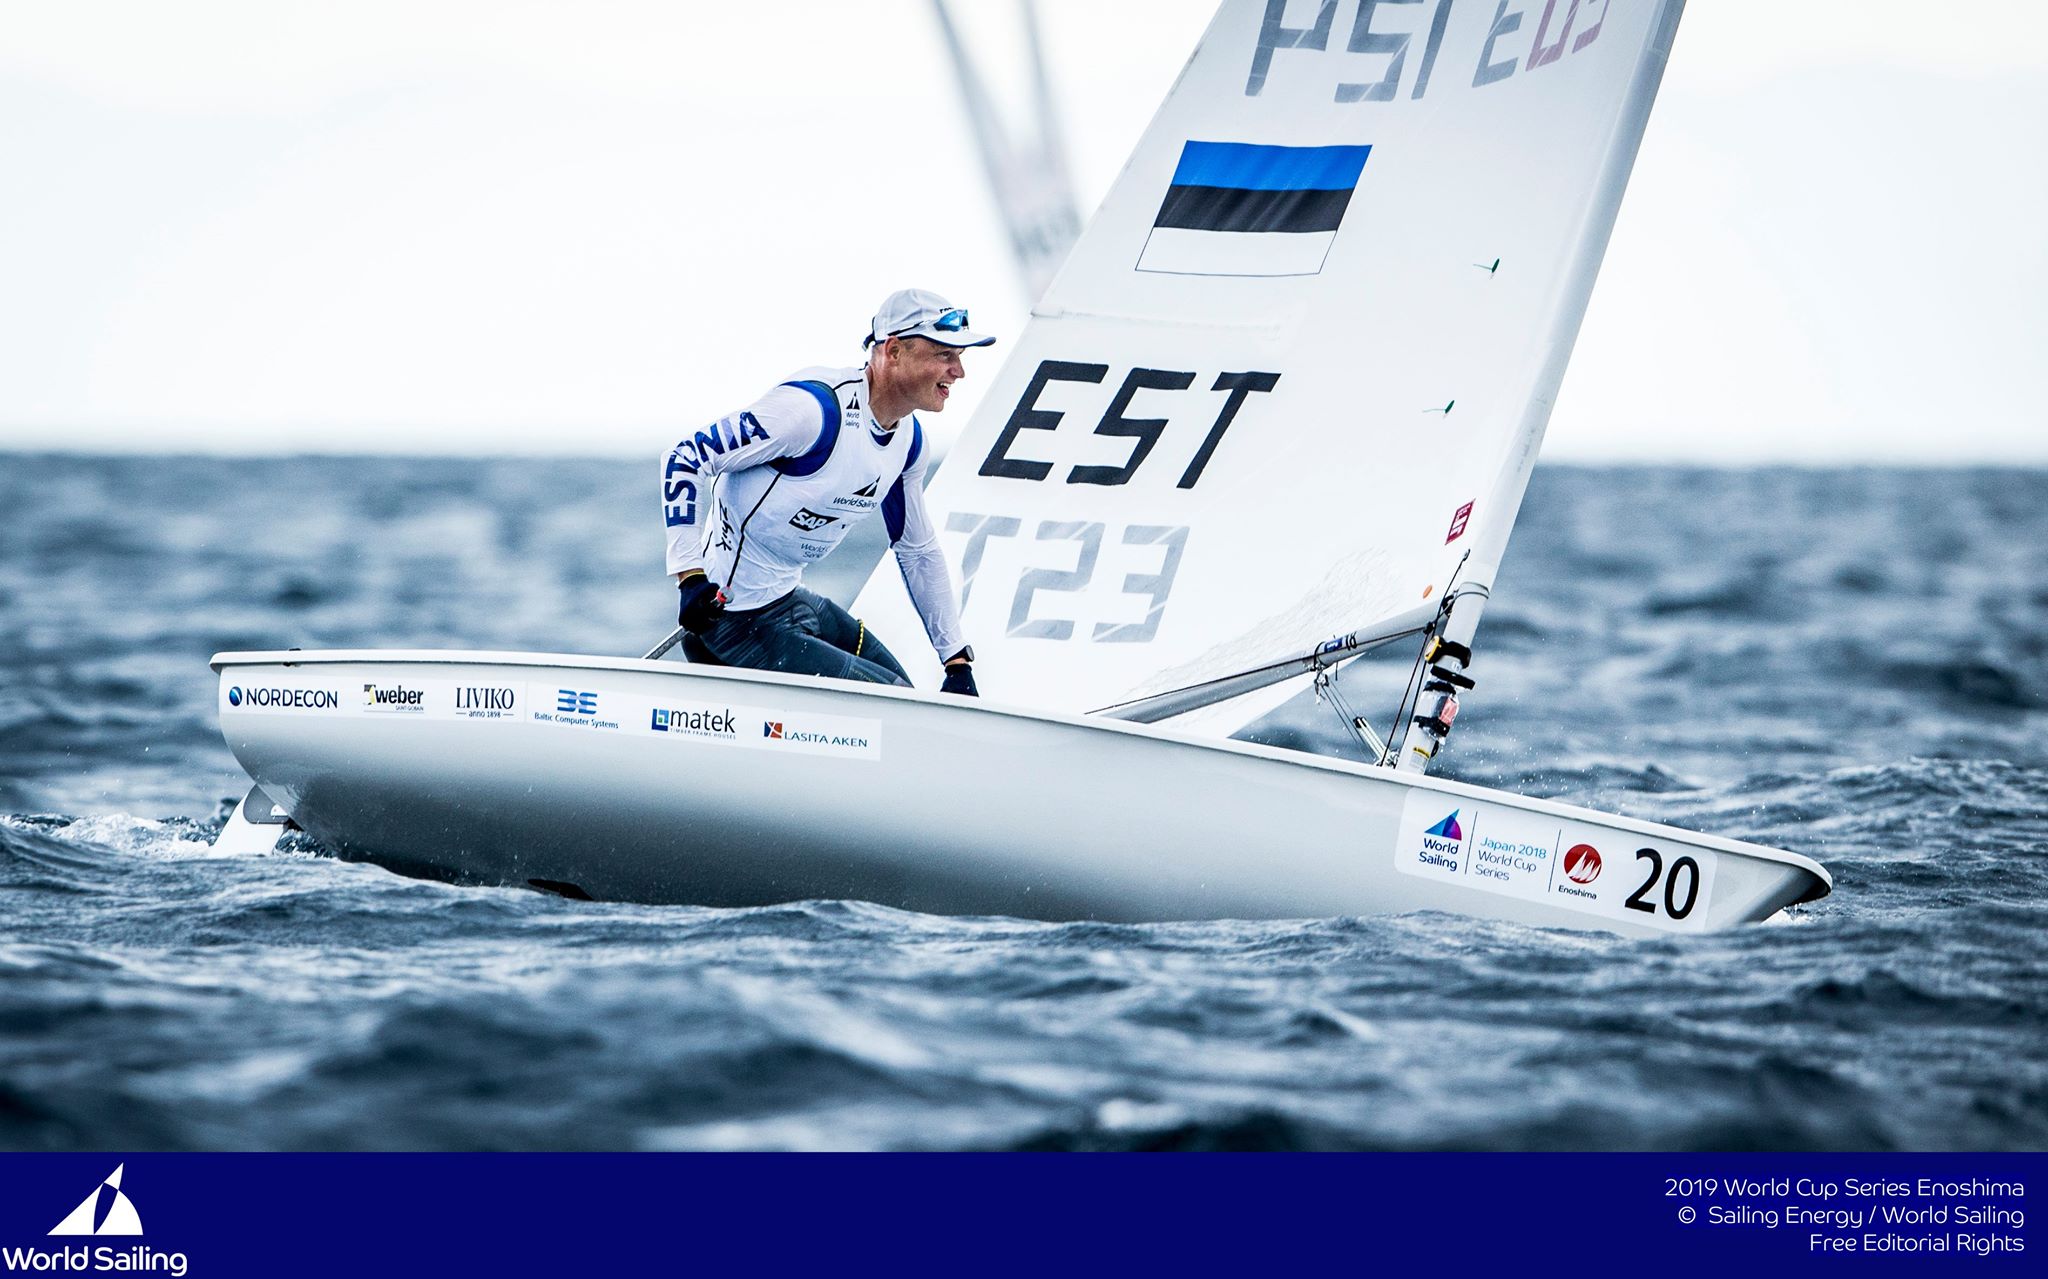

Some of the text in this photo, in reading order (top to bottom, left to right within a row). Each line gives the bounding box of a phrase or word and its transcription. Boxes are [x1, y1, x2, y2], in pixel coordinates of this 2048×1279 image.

[978, 360, 1282, 489] EST
[664, 411, 770, 528] ESTONIA
[832, 497, 857, 507] World
[792, 511, 828, 529] SAP
[246, 688, 338, 709] NORDECON
[375, 685, 424, 705] weber
[456, 687, 515, 710] LIVIKO
[487, 711, 501, 719] 1898
[534, 712, 619, 729] Baltic Computer Systems
[670, 709, 736, 734] matek
[784, 732, 868, 748] LASITA AKEN
[1423, 837, 1459, 855] World
[1480, 836, 1547, 860] Japan 2018
[1418, 851, 1458, 872] Sailing
[1477, 850, 1537, 873] World Cup
[1475, 863, 1510, 881] Series
[1558, 884, 1597, 900] Enoshima
[1624, 848, 1700, 920] 20
